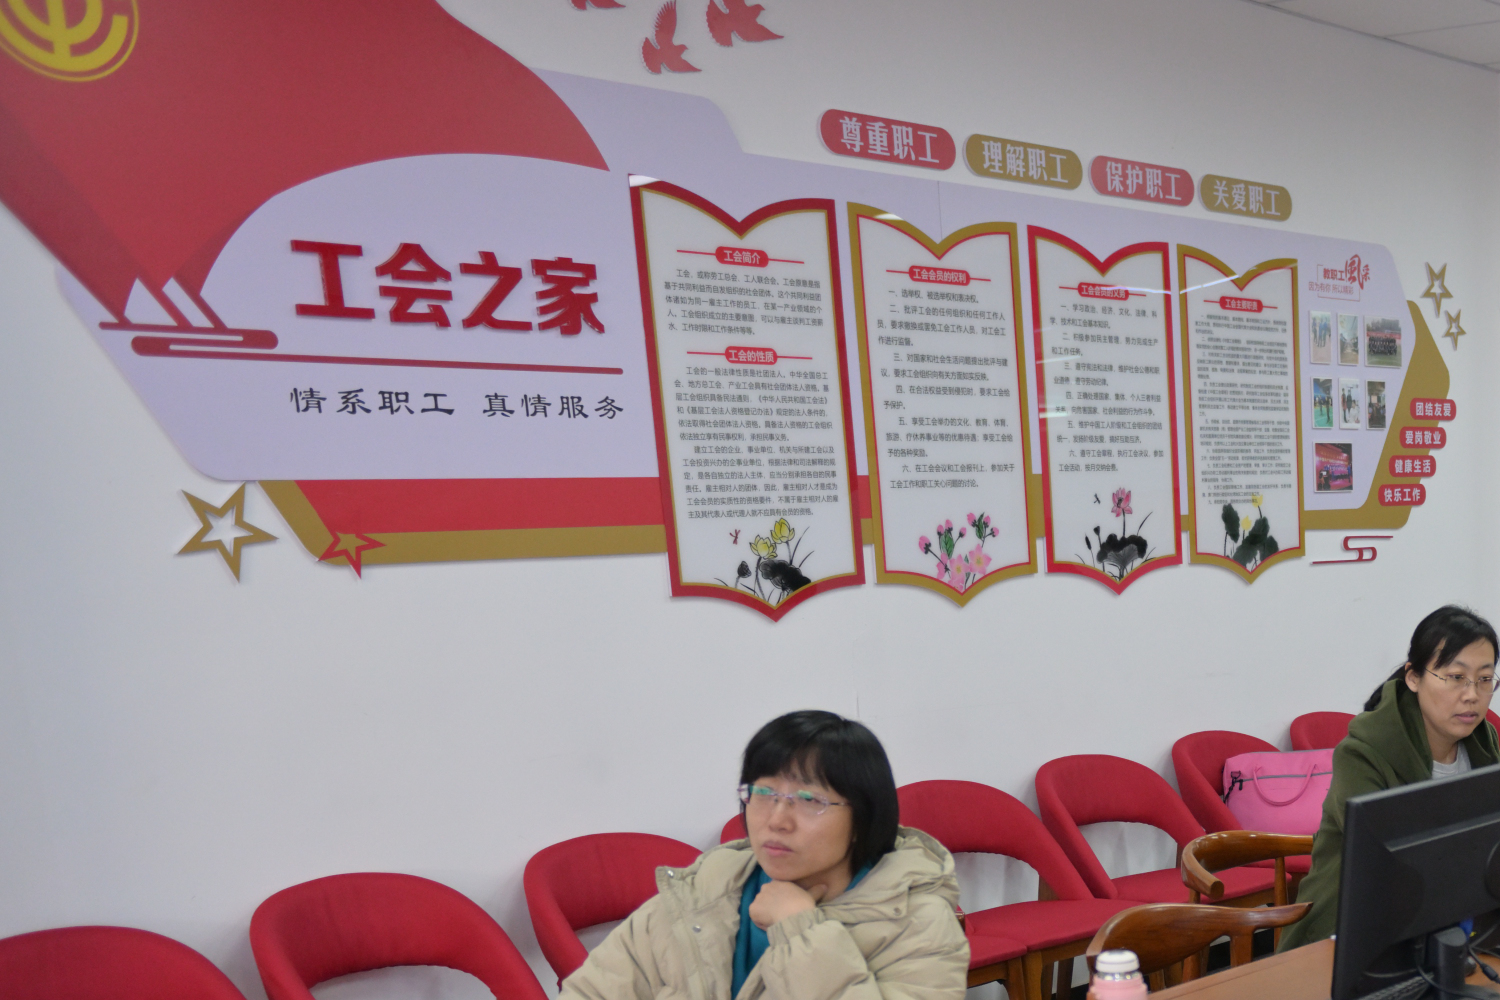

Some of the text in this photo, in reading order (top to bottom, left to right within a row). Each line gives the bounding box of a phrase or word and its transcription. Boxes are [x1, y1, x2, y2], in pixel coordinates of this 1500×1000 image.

[839, 116, 939, 163] 尊重职工
[982, 141, 1068, 184] 理解职工
[1106, 161, 1181, 200] 保护职工
[1213, 180, 1280, 215] 关爱职工
[724, 250, 760, 264] 工会简介
[913, 268, 966, 283] 工会会员的权利
[290, 240, 605, 336] 工会之家
[1308, 282, 1331, 292] 因为有你
[1225, 299, 1258, 310] 工会主要职责
[729, 350, 774, 363] 工会的性质
[290, 388, 624, 419] 情系职工 真情服务
[1415, 402, 1451, 416] 团结友爱
[1405, 431, 1441, 444] 爱岗敬业
[1395, 459, 1431, 473] 健康生活
[1384, 488, 1420, 502] 快乐工作
